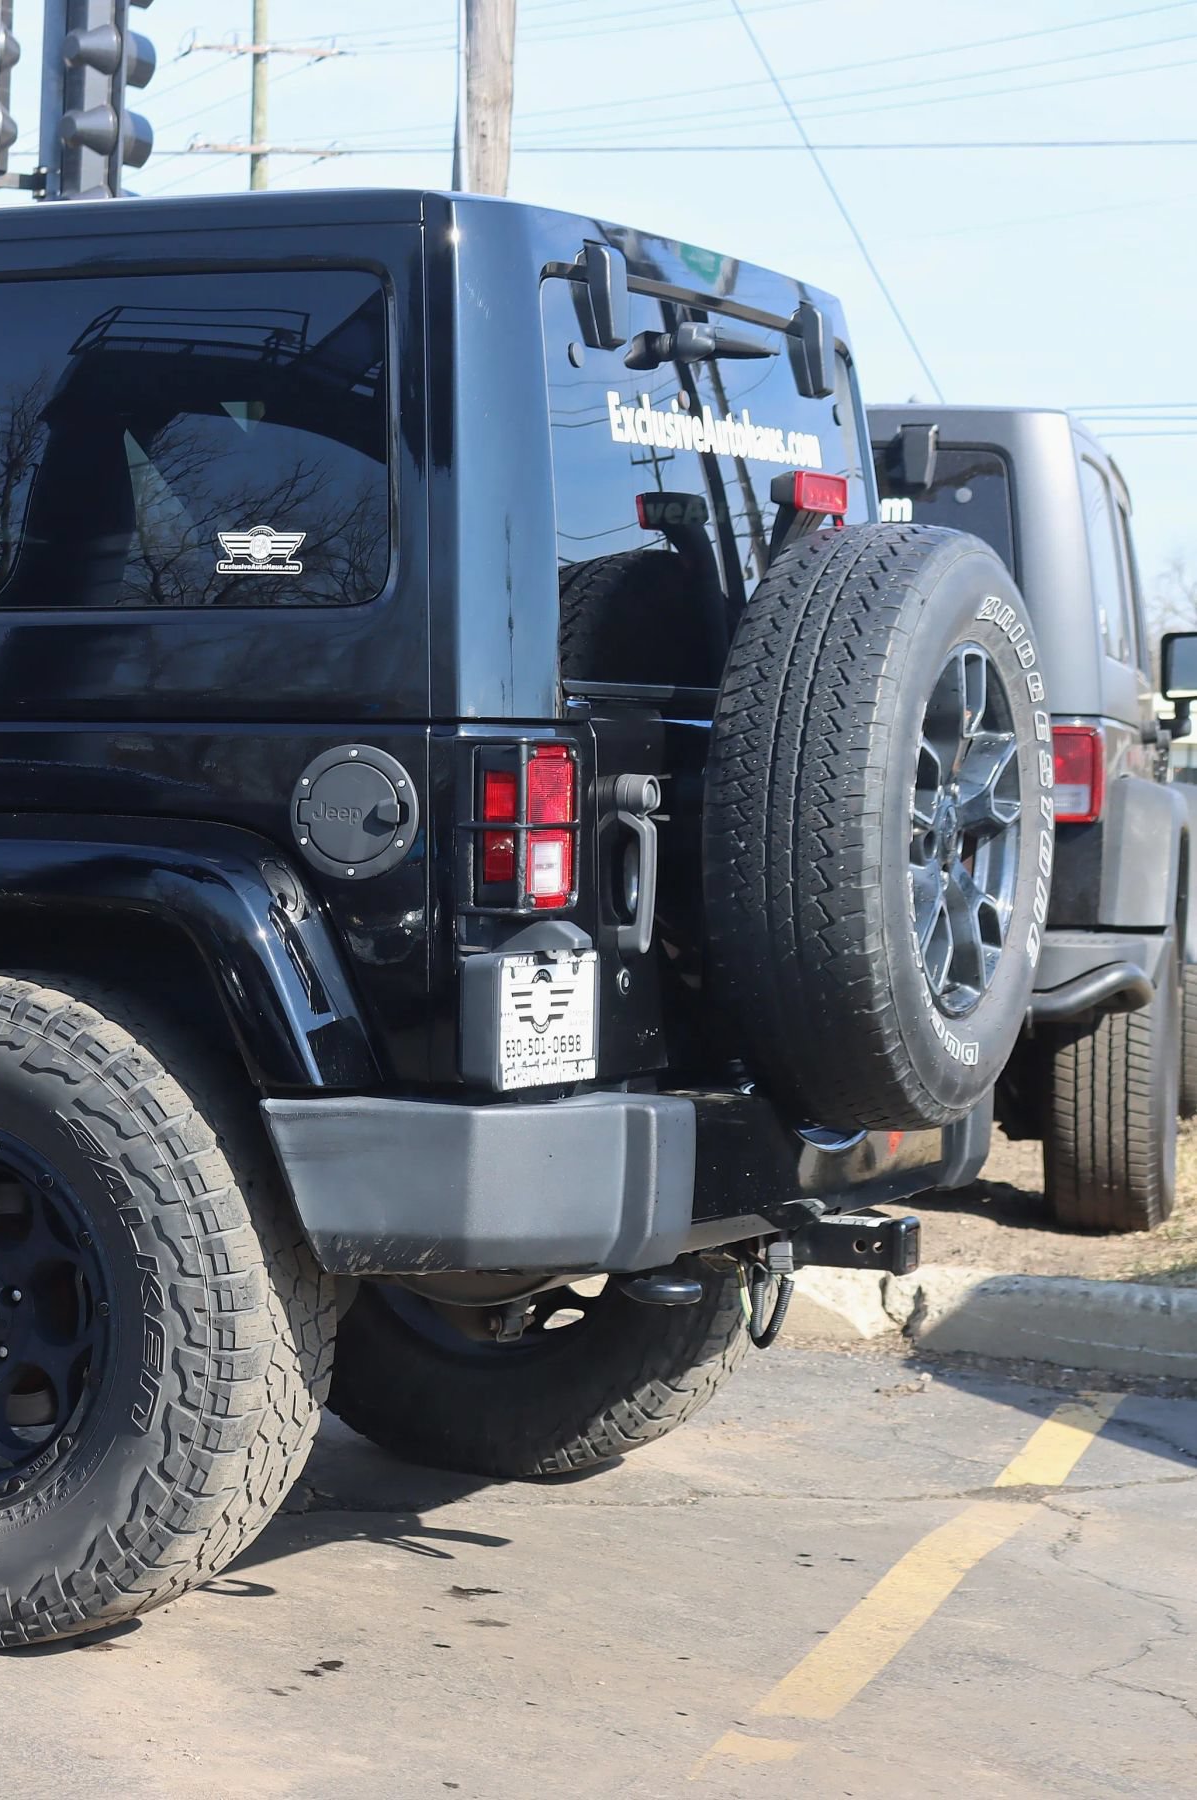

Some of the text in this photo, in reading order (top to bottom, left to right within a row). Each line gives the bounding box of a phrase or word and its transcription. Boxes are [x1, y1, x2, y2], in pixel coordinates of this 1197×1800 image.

[312, 801, 363, 825] Jeep
[975, 595, 1055, 969] BRIDGESTONE
[505, 1033, 581, 1059] 630-501-0698
[54, 1109, 167, 1435] FALKEN
